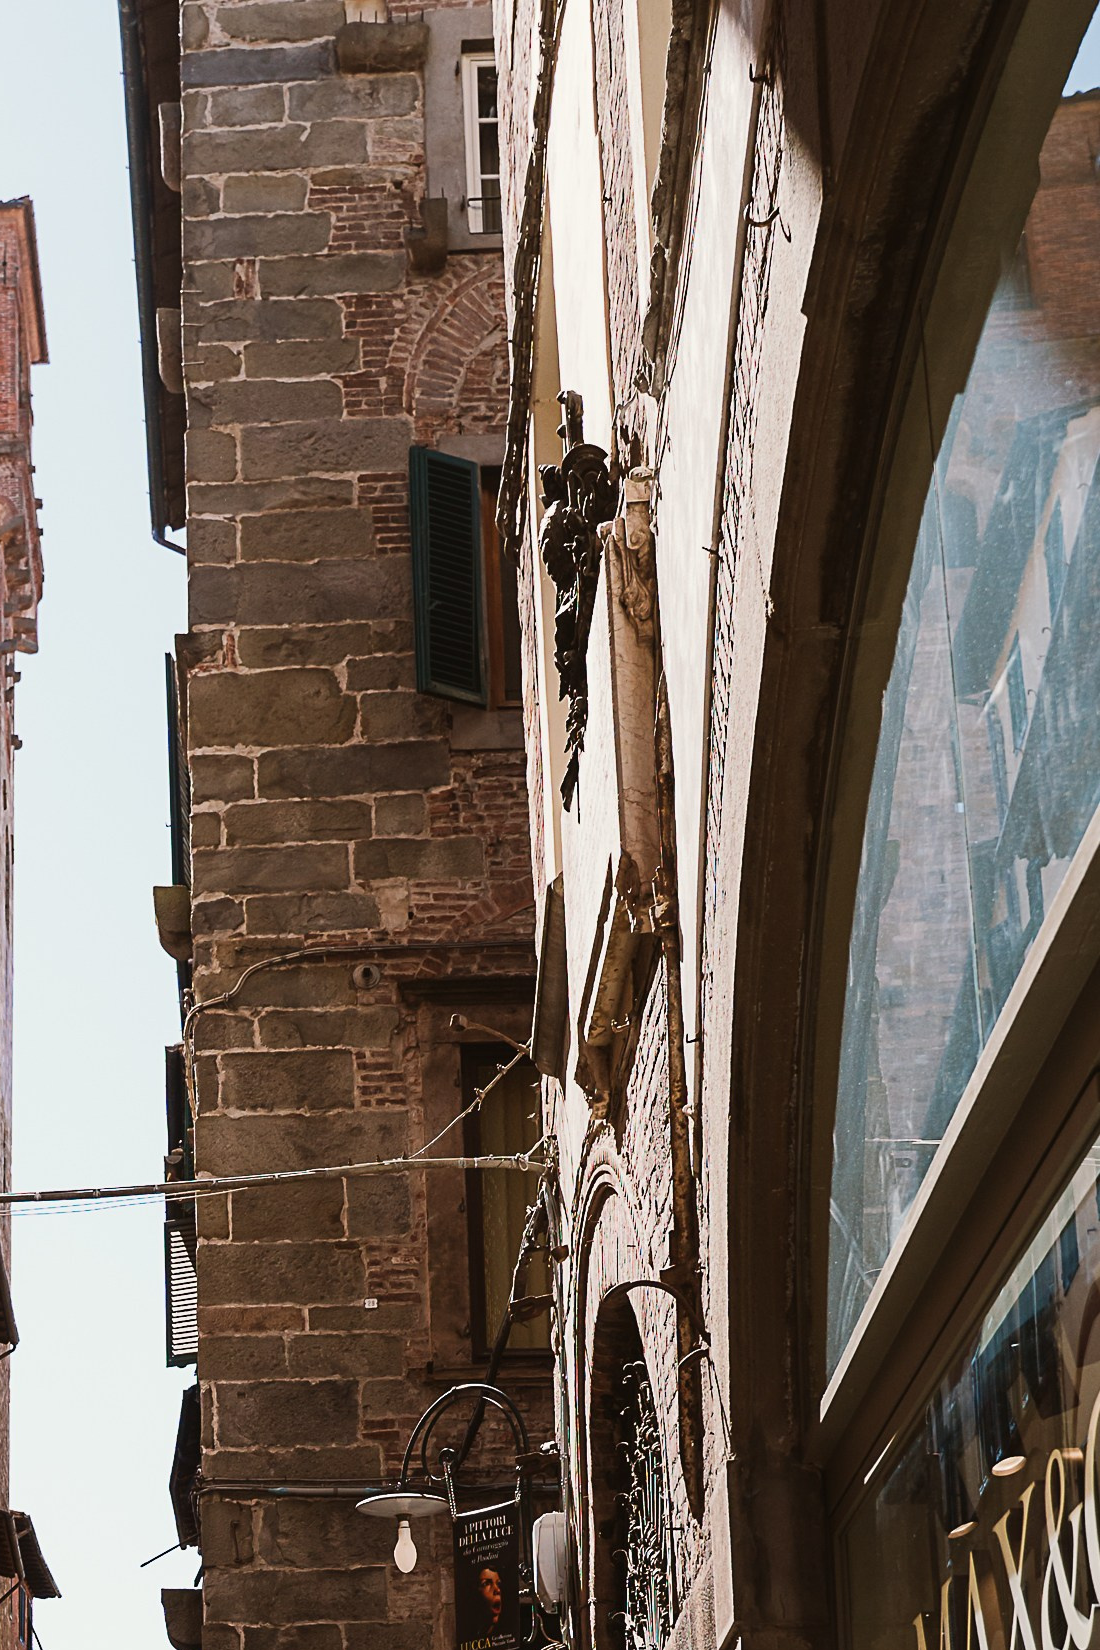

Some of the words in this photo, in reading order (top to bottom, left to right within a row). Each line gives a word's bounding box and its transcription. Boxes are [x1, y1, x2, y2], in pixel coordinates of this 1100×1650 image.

[469, 1515, 506, 1533] PITTORI
[459, 1532, 487, 1547] DELLA
[489, 1525, 514, 1540] LUCE
